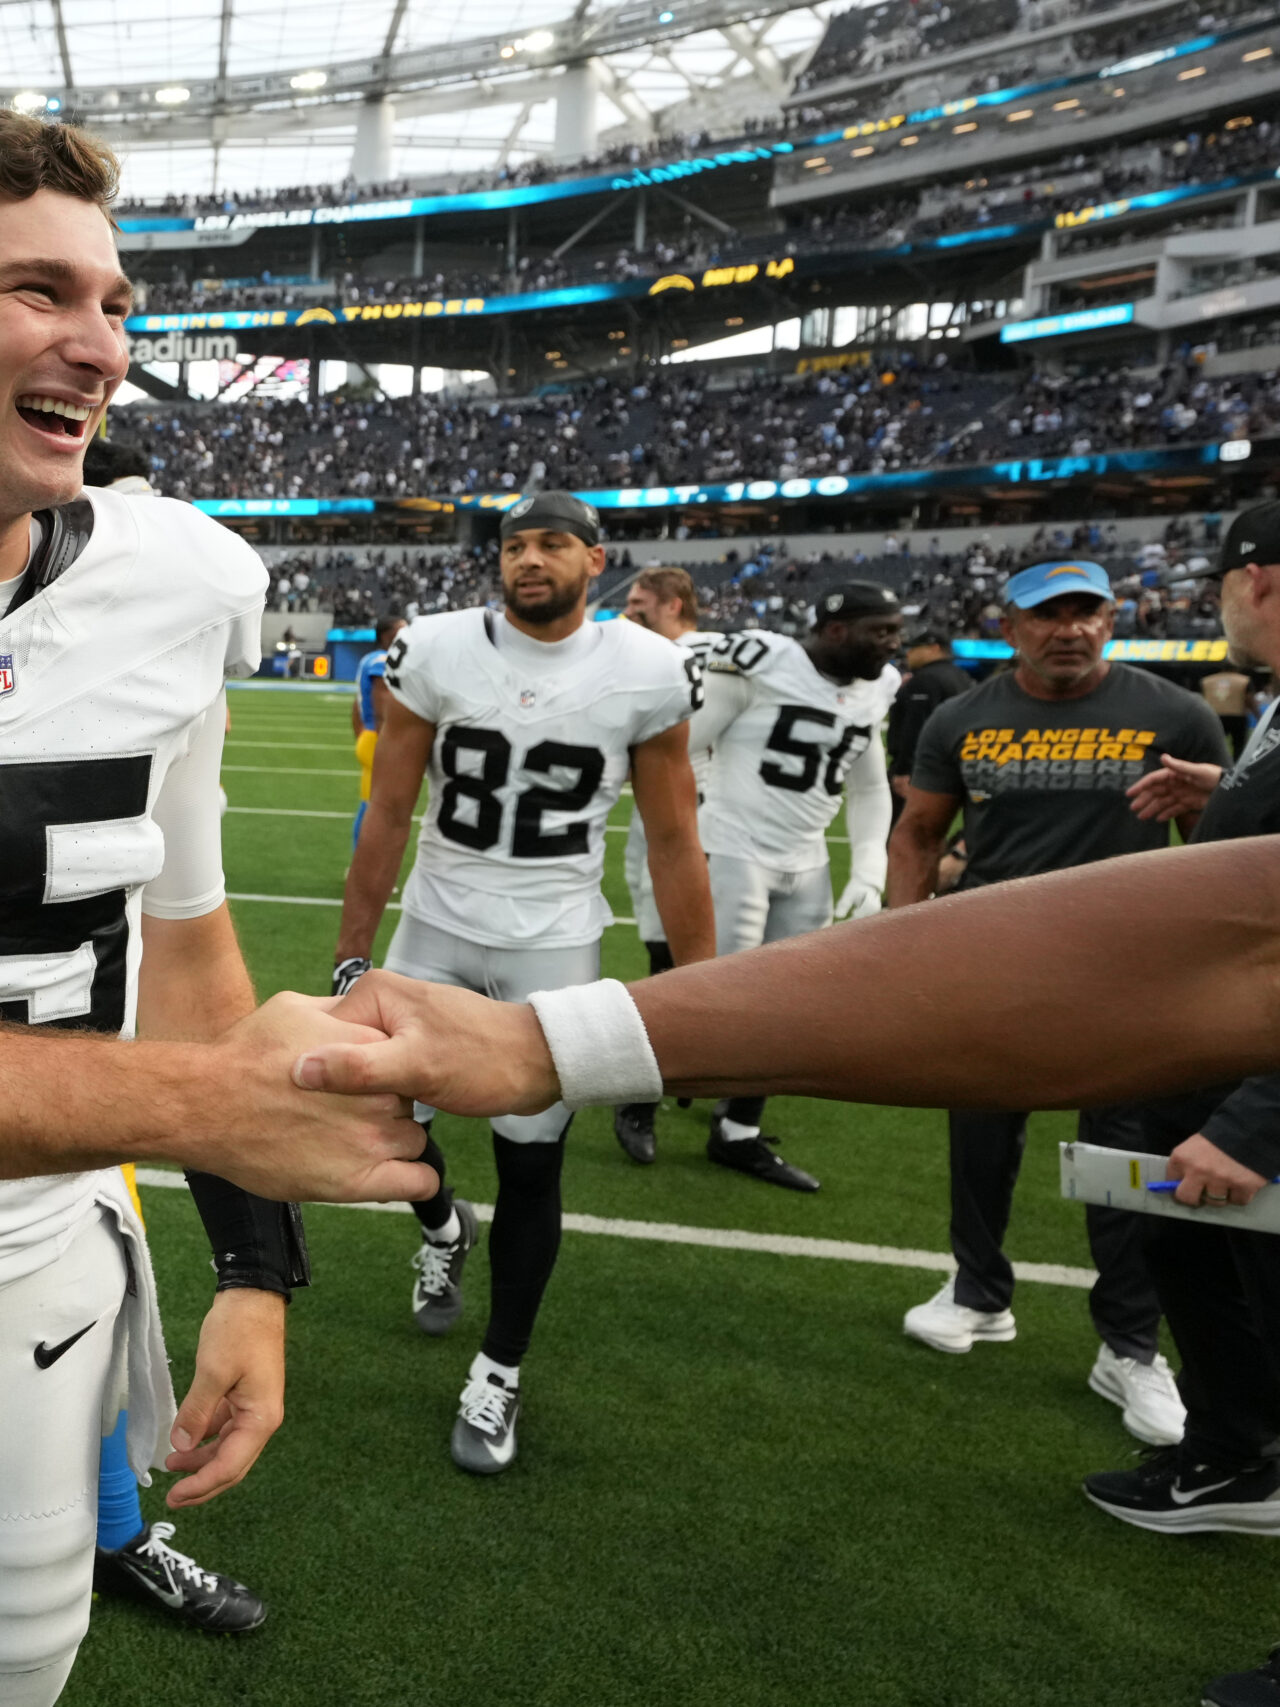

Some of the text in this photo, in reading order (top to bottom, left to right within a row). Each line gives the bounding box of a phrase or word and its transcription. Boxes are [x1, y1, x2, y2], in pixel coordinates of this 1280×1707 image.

[146, 298, 484, 330] BRING THE THUNDER
[1108, 639, 1228, 662] ANGELES
[964, 728, 1156, 745] LOS ANGELES
[960, 743, 1147, 767] CHARGERS
[961, 760, 1145, 777] CHARGERS
[437, 726, 606, 857] 82
